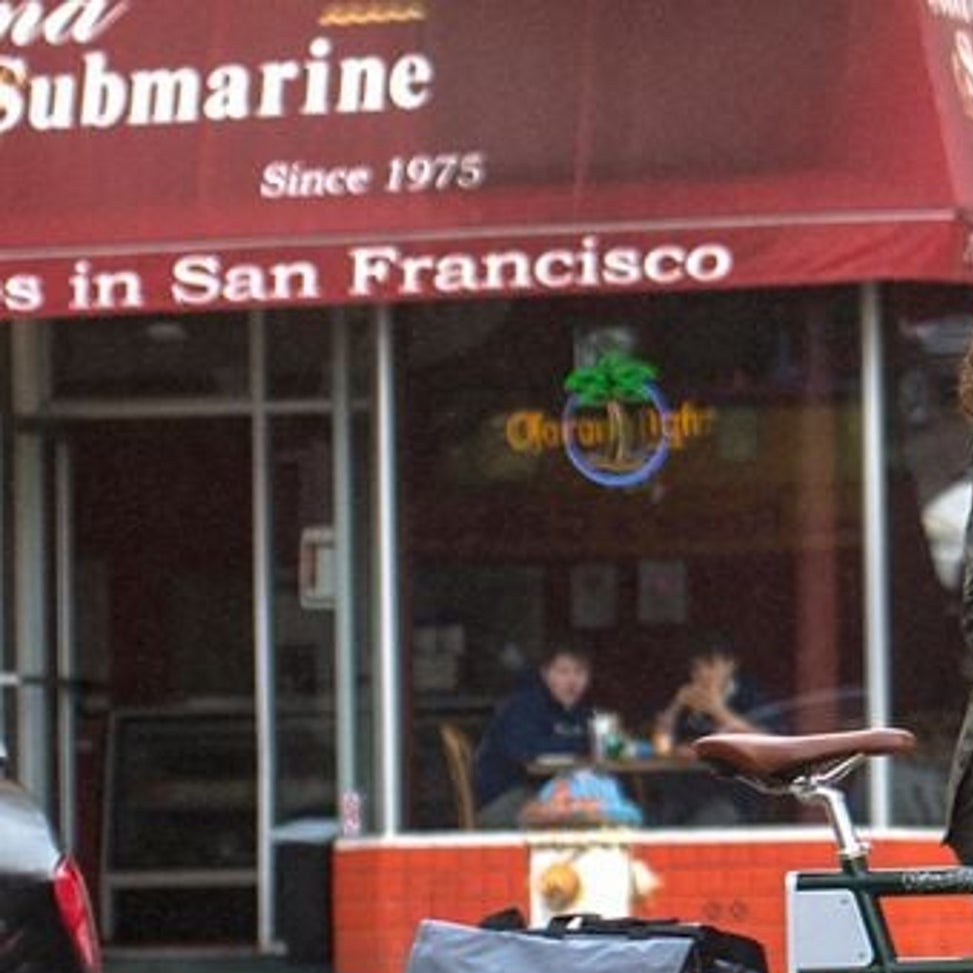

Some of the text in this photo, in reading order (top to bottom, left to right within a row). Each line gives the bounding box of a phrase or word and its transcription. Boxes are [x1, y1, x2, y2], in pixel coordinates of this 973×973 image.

[0, 37, 434, 134] Submarine
[260, 152, 486, 199] Since 1975
[69, 259, 144, 311] in
[172, 253, 321, 305] San
[347, 235, 734, 297] Francisco
